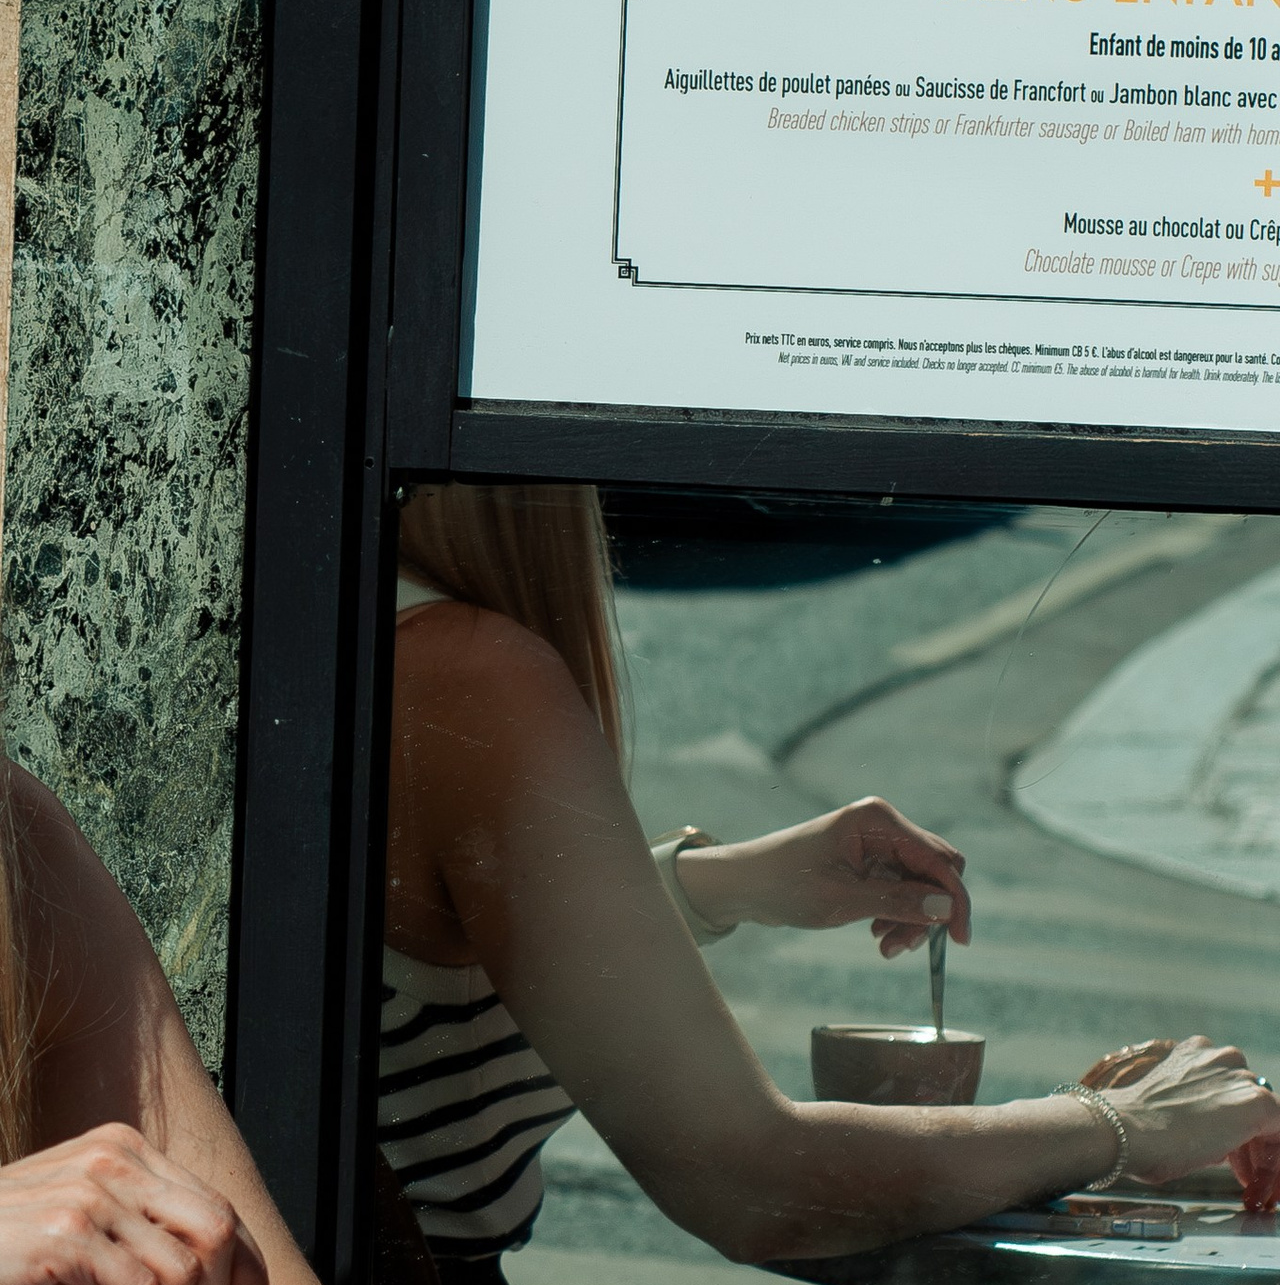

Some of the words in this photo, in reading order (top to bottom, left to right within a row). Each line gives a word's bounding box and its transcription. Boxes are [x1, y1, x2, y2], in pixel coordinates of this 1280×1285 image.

[1090, 32, 1142, 56] Enfant
[1147, 34, 1165, 57] de
[1170, 35, 1219, 59] moins
[1224, 36, 1243, 59] de
[1250, 37, 1266, 60] 10
[745, 332, 760, 344] Prix
[762, 334, 779, 345] nets
[781, 334, 795, 345] TTC
[797, 337, 806, 346] en
[808, 338, 831, 348] euros,
[833, 337, 861, 348] service
[863, 338, 896, 352] compris.
[898, 338, 917, 351] Nous
[966, 341, 983, 355] plus
[985, 342, 997, 354] les
[998, 343, 1032, 357] chèques.
